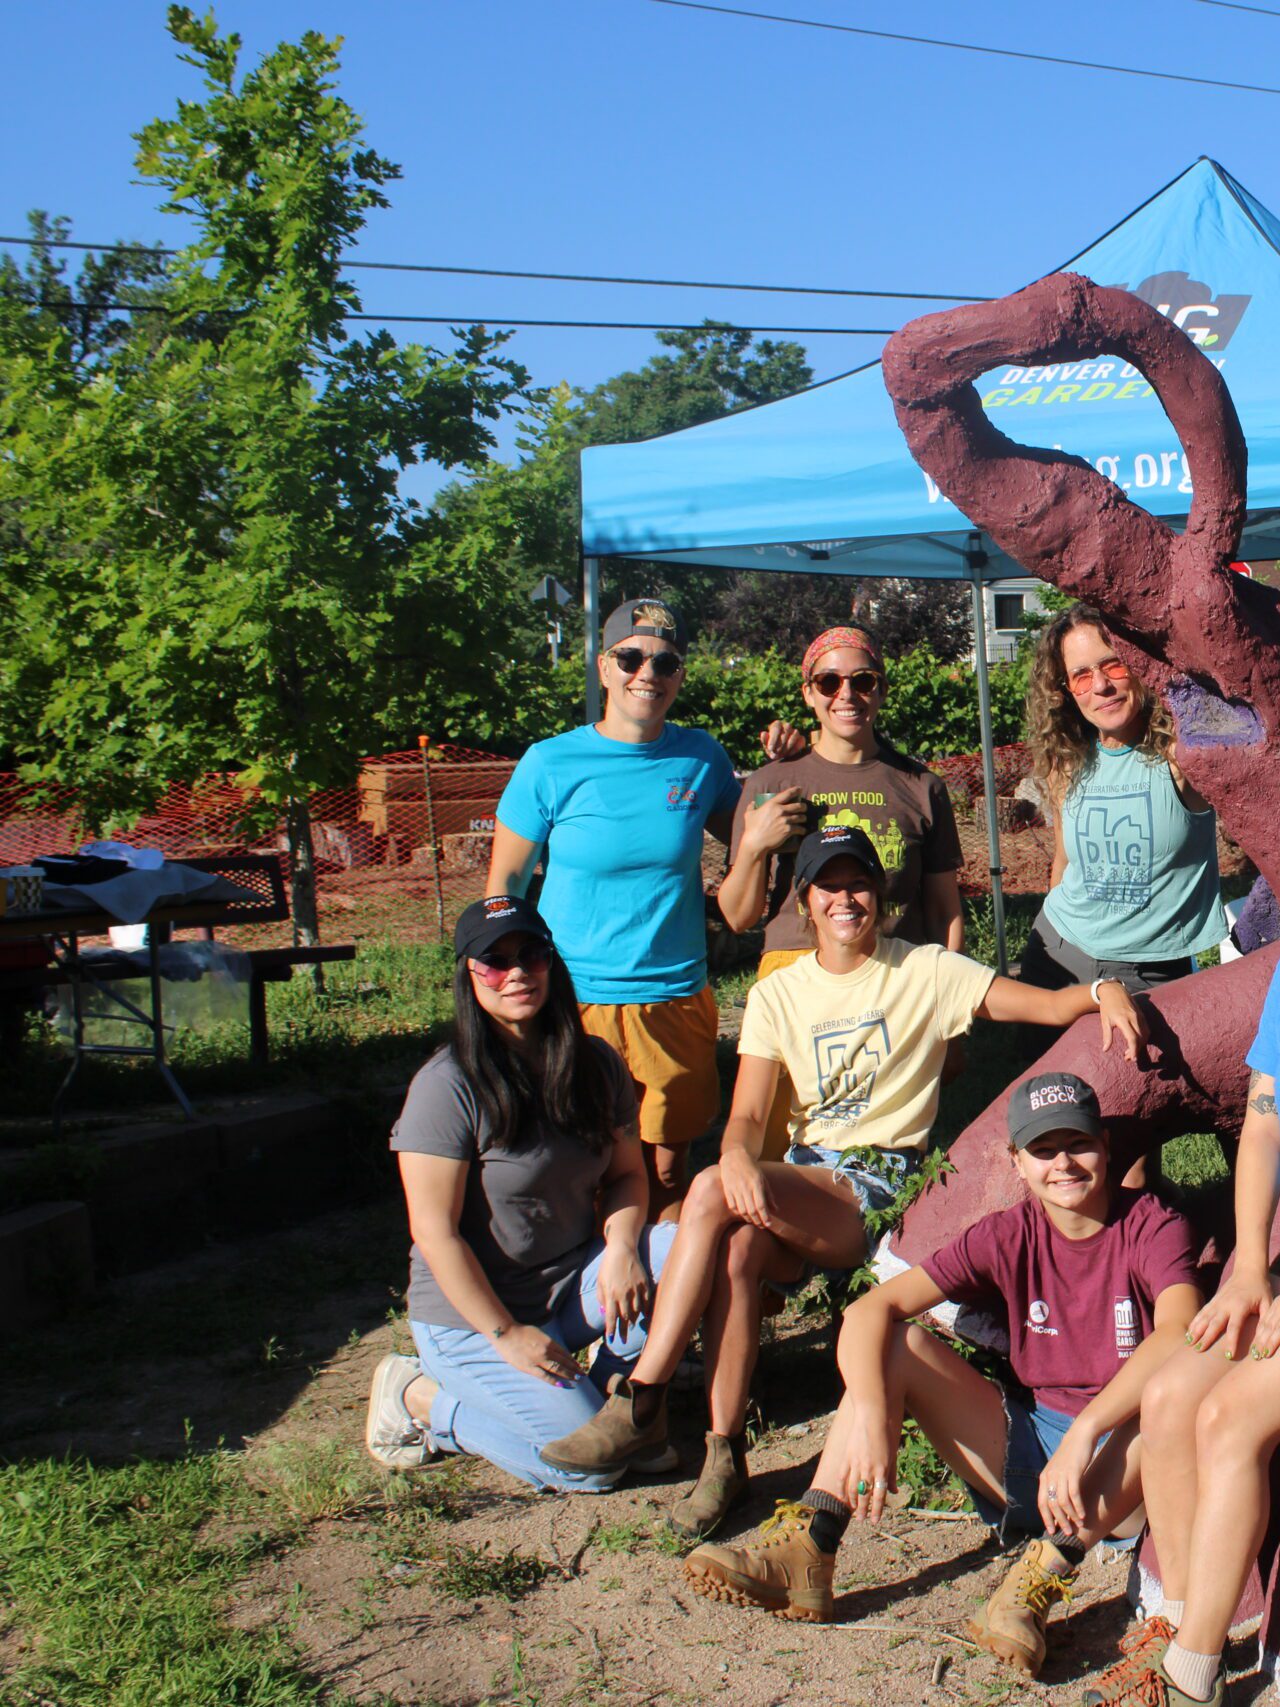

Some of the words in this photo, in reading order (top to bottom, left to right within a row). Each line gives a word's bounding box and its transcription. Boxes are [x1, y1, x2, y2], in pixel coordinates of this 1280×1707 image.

[999, 362, 1115, 385] DENVER
[981, 379, 1156, 408] GARDE
[851, 791, 887, 806] FOOD.
[1086, 840, 1147, 867] D.U.G.
[811, 1016, 856, 1034] CELEBRATING
[1030, 1084, 1061, 1099] BLOCK
[1062, 1084, 1075, 1095] TO
[1030, 1091, 1079, 1111] BLOCK
